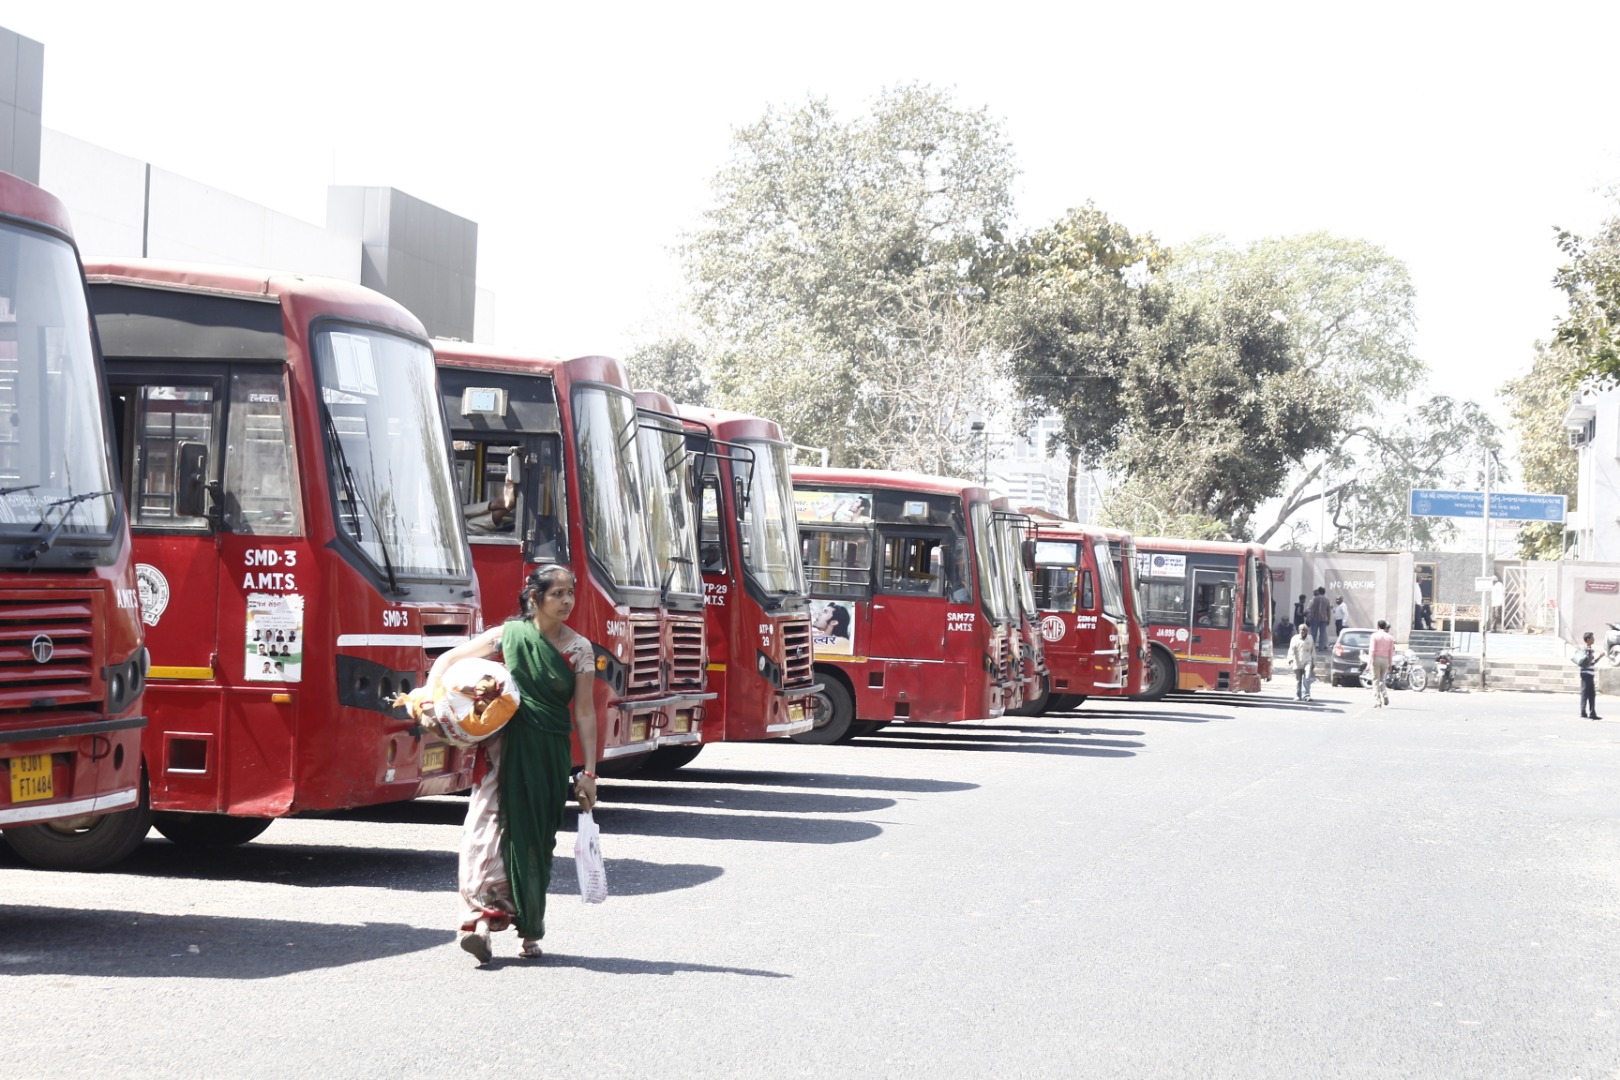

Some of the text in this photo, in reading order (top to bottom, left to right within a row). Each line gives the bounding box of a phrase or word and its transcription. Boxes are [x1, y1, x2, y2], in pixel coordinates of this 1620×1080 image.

[703, 582, 728, 594] TP-29
[1329, 580, 1376, 590] NO PARKING
[813, 636, 837, 645] ल्वर
[20, 774, 52, 798] FT1484
